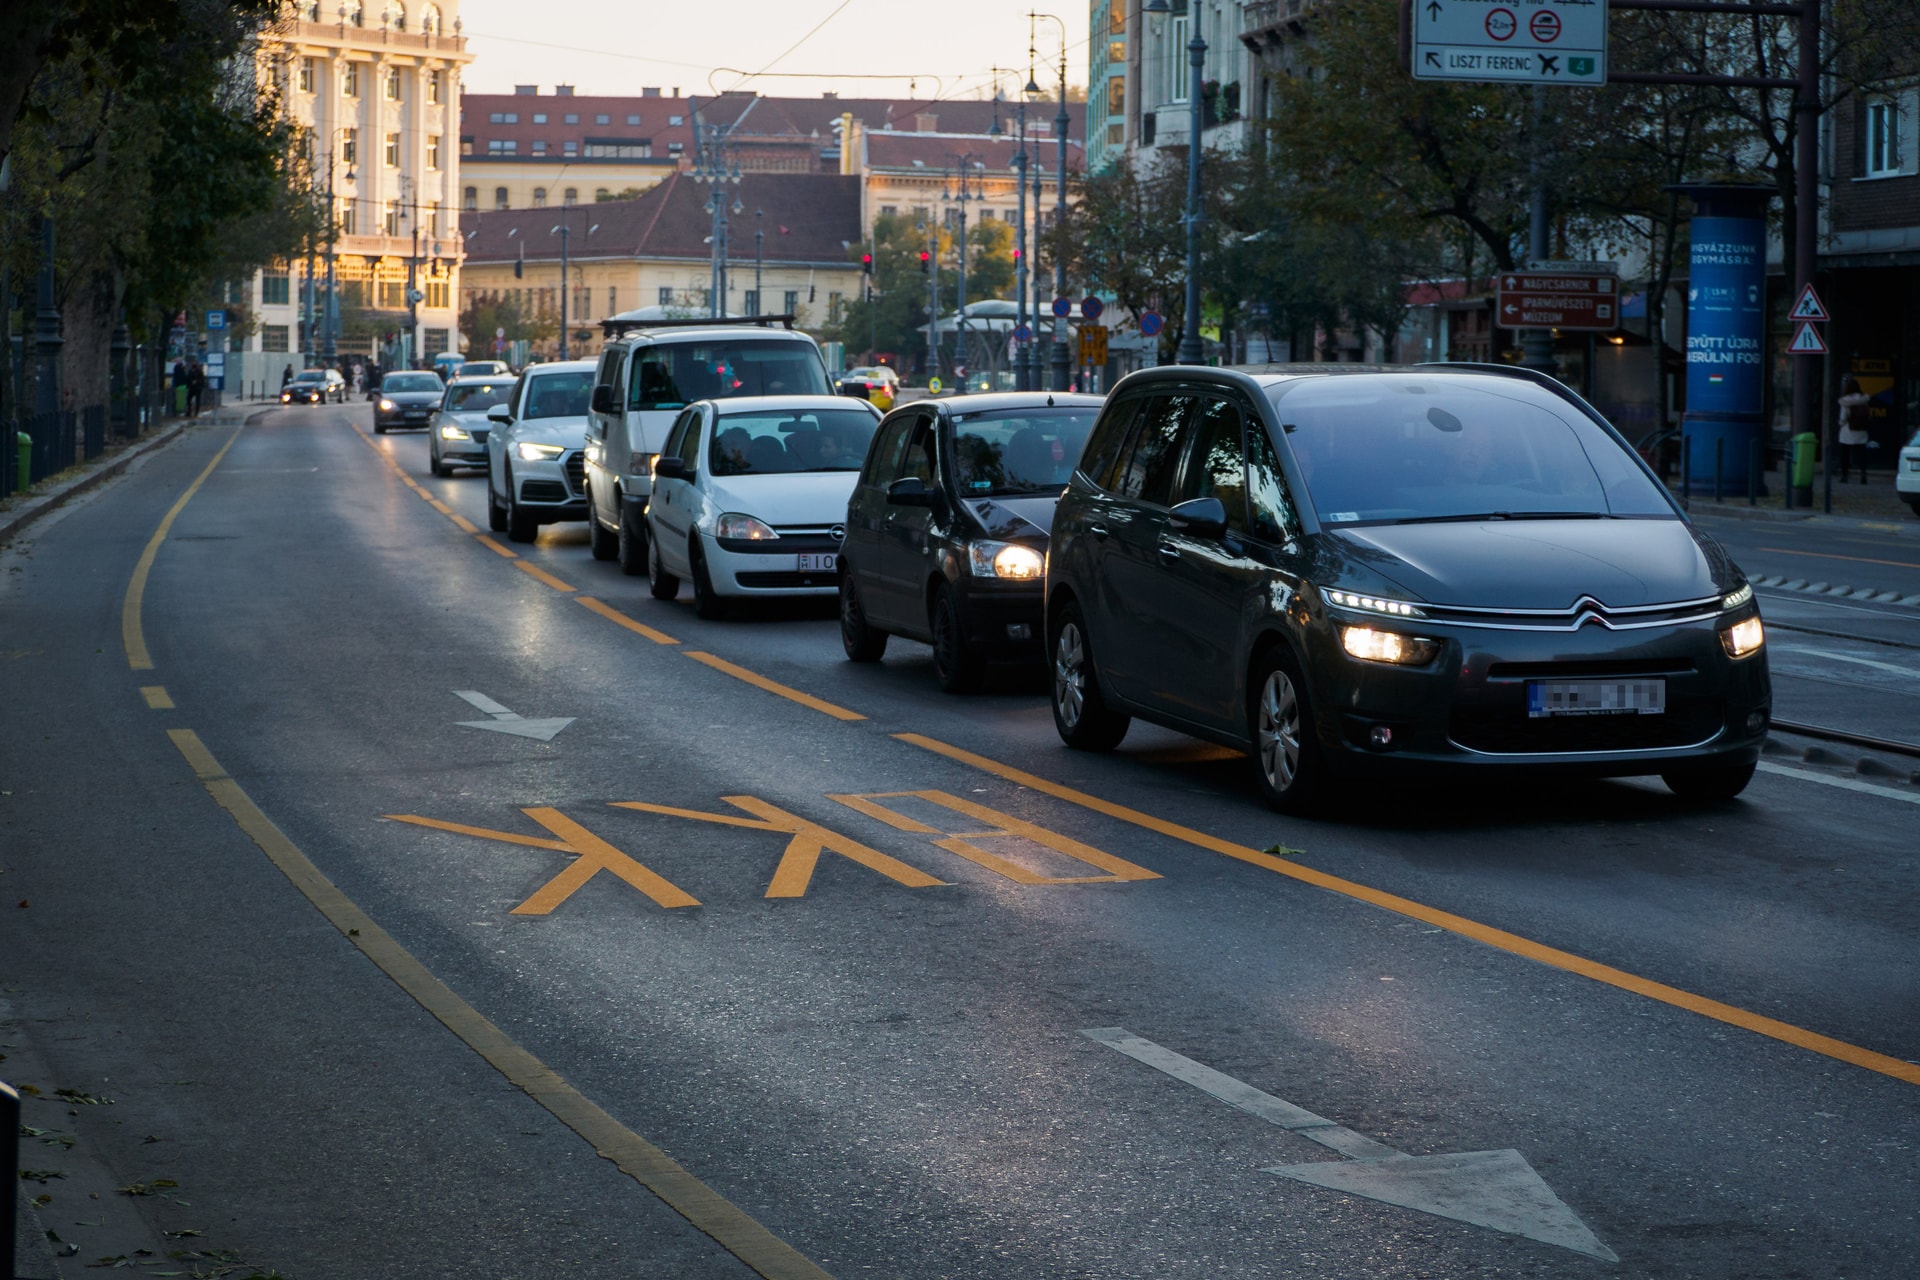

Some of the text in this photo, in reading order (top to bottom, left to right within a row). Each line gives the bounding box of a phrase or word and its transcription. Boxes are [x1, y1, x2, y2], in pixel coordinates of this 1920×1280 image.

[1450, 54, 1532, 71] LISZT FERENC
[1575, 60, 1585, 71] 4
[1523, 309, 1563, 322] MÚZEUM
[1736, 352, 1761, 365] FOG
[815, 555, 838, 569] IO
